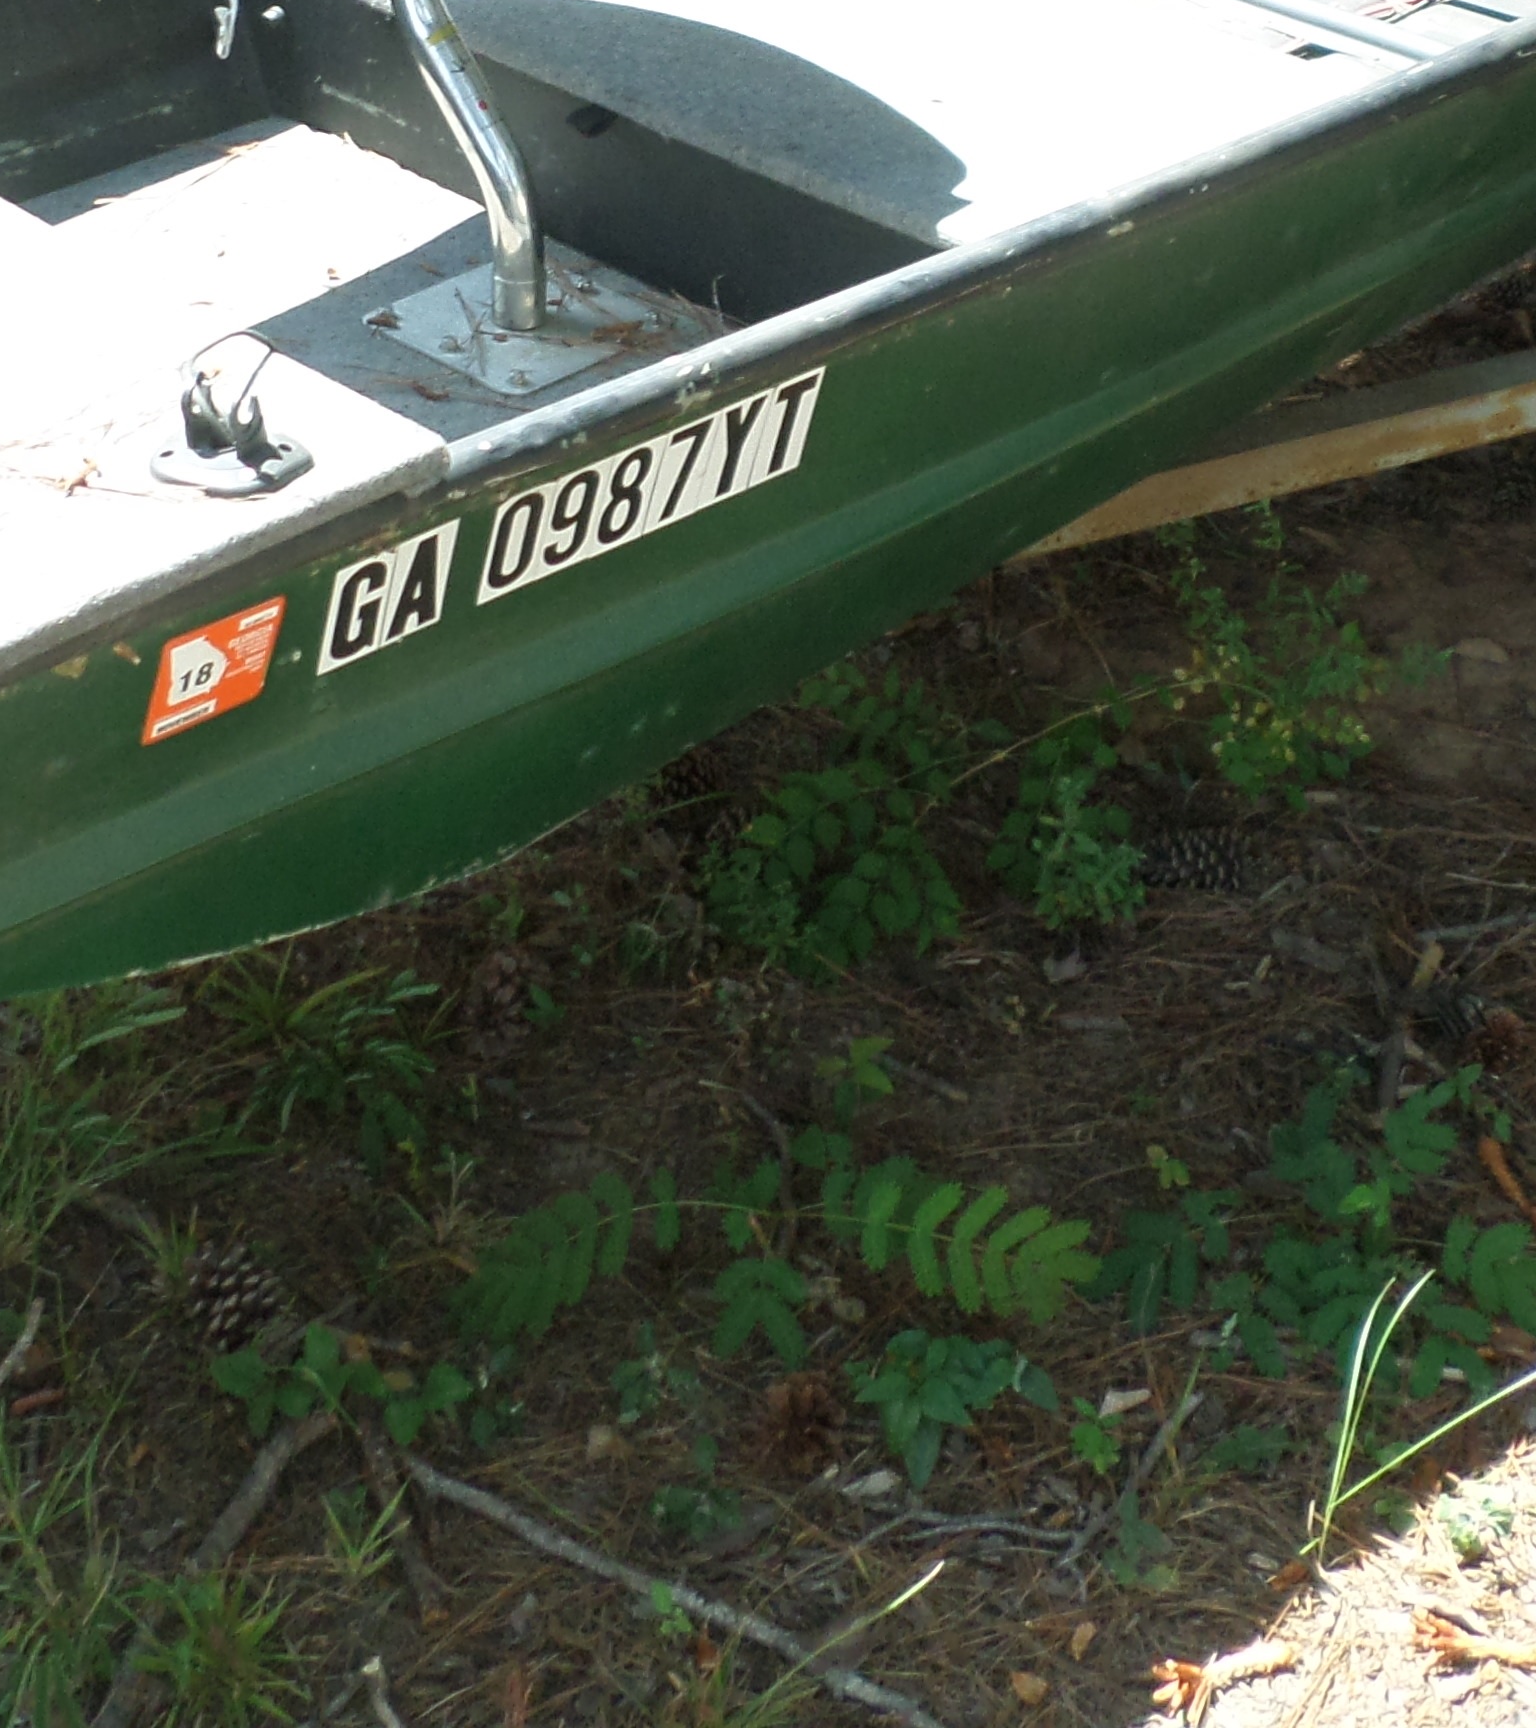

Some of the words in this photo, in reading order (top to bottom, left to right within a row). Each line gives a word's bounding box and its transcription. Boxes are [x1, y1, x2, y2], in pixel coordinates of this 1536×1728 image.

[330, 533, 440, 661] GA
[487, 371, 822, 590] 0987YT
[179, 661, 214, 693] 18
